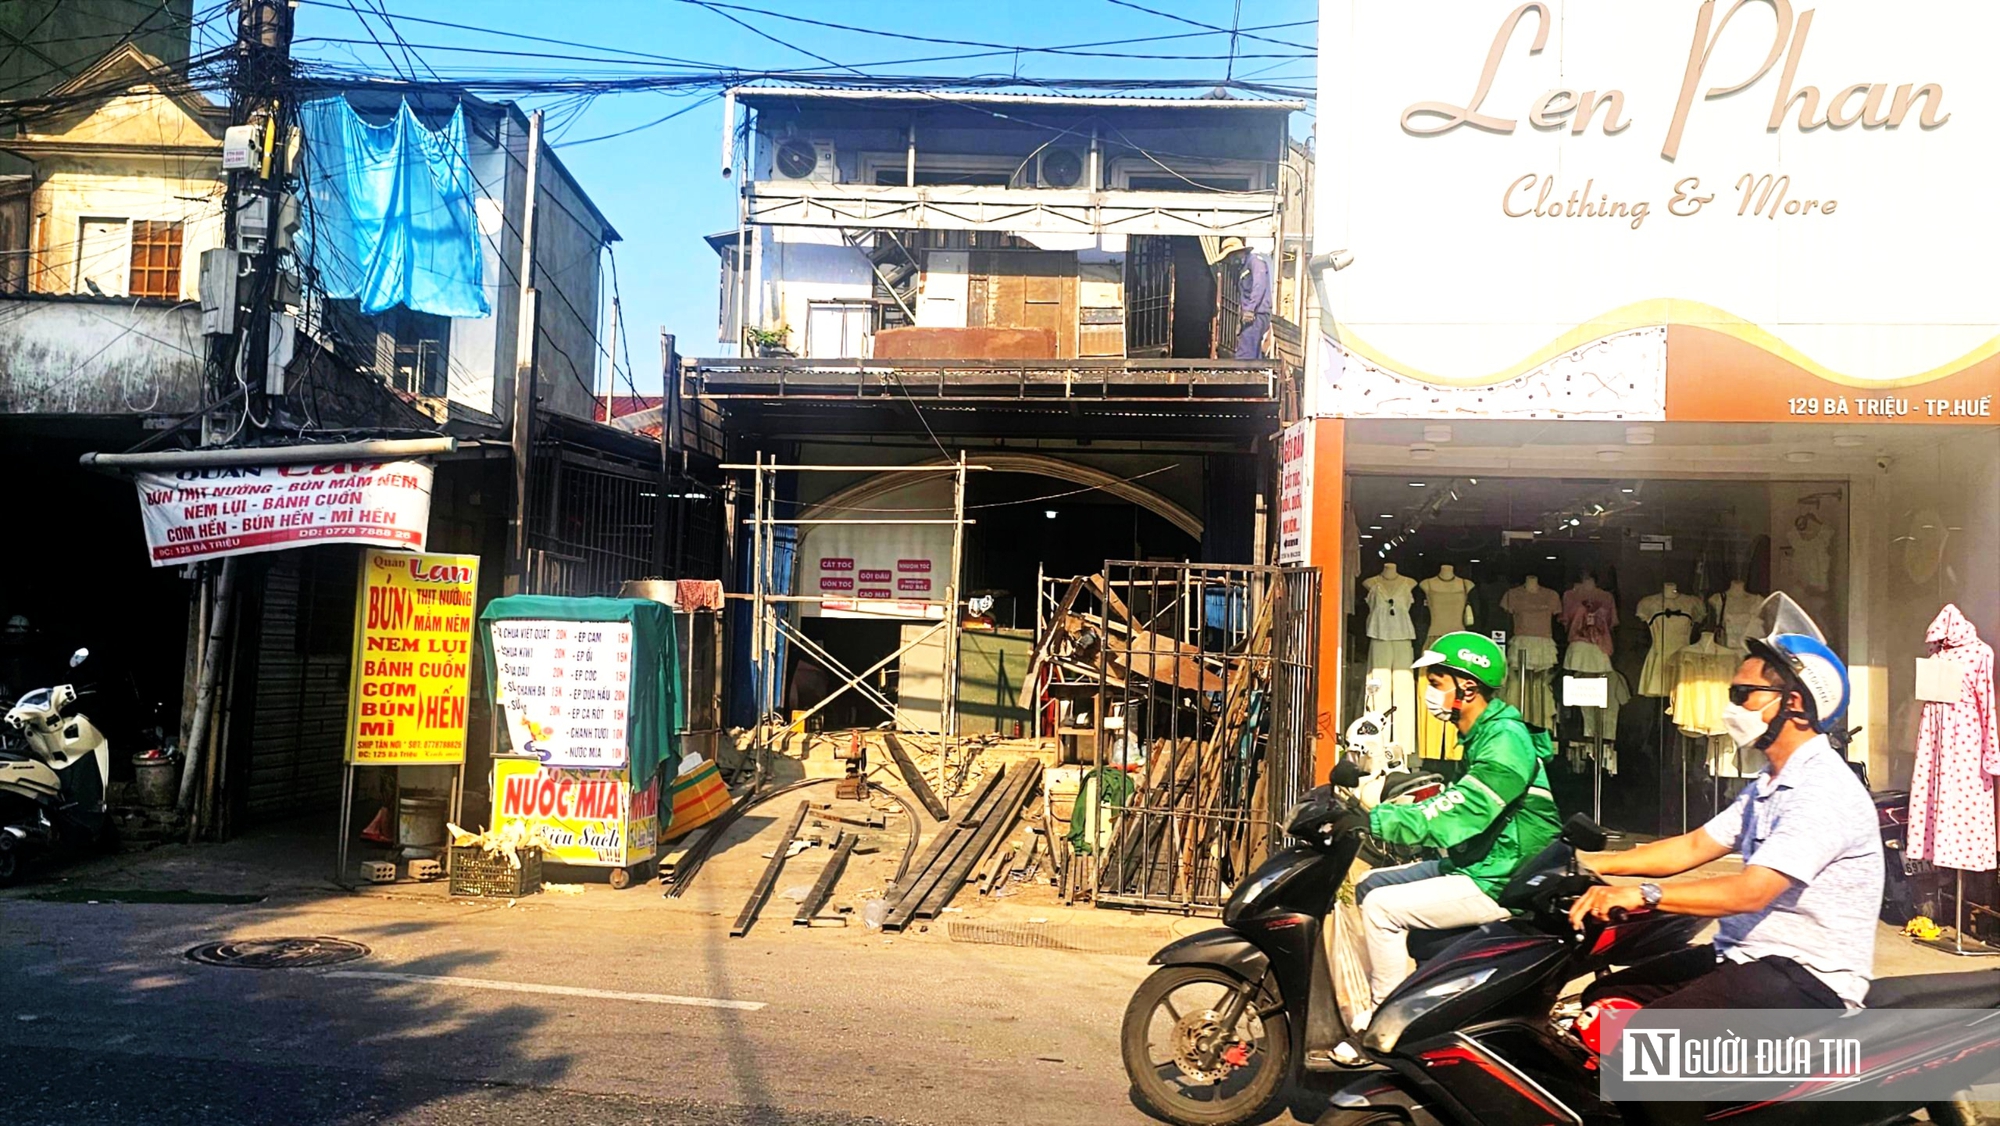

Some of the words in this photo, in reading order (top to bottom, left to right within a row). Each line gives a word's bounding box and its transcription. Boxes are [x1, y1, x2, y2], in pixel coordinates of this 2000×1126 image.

[1401, 1, 1632, 136] Len
[1660, 0, 1951, 163] Phan
[1502, 173, 1650, 229] Clothing
[1668, 177, 1715, 217] &
[1735, 173, 1838, 219] More
[1788, 397, 1819, 415] 129
[1823, 395, 1849, 415] BÀ
[1855, 395, 1908, 418] TRIỆU
[1924, 394, 1991, 417] TP.HUẾ
[146, 489, 173, 506] BÚN
[177, 487, 209, 503] THỊT
[211, 483, 273, 497] NƯỚNG
[288, 479, 325, 492] BÚN
[184, 503, 217, 520] NEM
[222, 500, 247, 517] LỤI
[263, 494, 310, 510] BÁNH
[315, 489, 363, 506] CUỐN
[167, 525, 196, 542] CƠM
[198, 518, 227, 538] HẾN
[242, 514, 275, 532] BÚN
[280, 509, 314, 527] HẾN
[331, 507, 353, 523] MÌ
[359, 507, 397, 524] HẾN
[175, 545, 191, 554] 125
[209, 537, 240, 549] TRIỆU
[325, 527, 356, 535] 0778
[360, 528, 391, 537] 7888
[409, 558, 472, 584] Lan
[367, 573, 406, 630] BÚN
[416, 588, 437, 608] THỊT
[439, 586, 472, 606] NƯỚNG
[445, 613, 470, 633] NÊM
[366, 636, 420, 652] NEM
[428, 639, 467, 657] LỤI
[1457, 648, 1491, 668] Grab
[364, 657, 413, 677] BÁNH
[419, 657, 466, 678] CUỐN
[362, 681, 416, 697] CƠM
[361, 699, 415, 717] BÚN
[425, 684, 465, 729] HẾN
[360, 719, 394, 736] MÌ
[357, 740, 373, 749] SHIP
[373, 750, 386, 758] 125
[504, 769, 573, 817] NƯỚC
[574, 769, 619, 819] MÍA
[578, 826, 619, 850] Sạch
